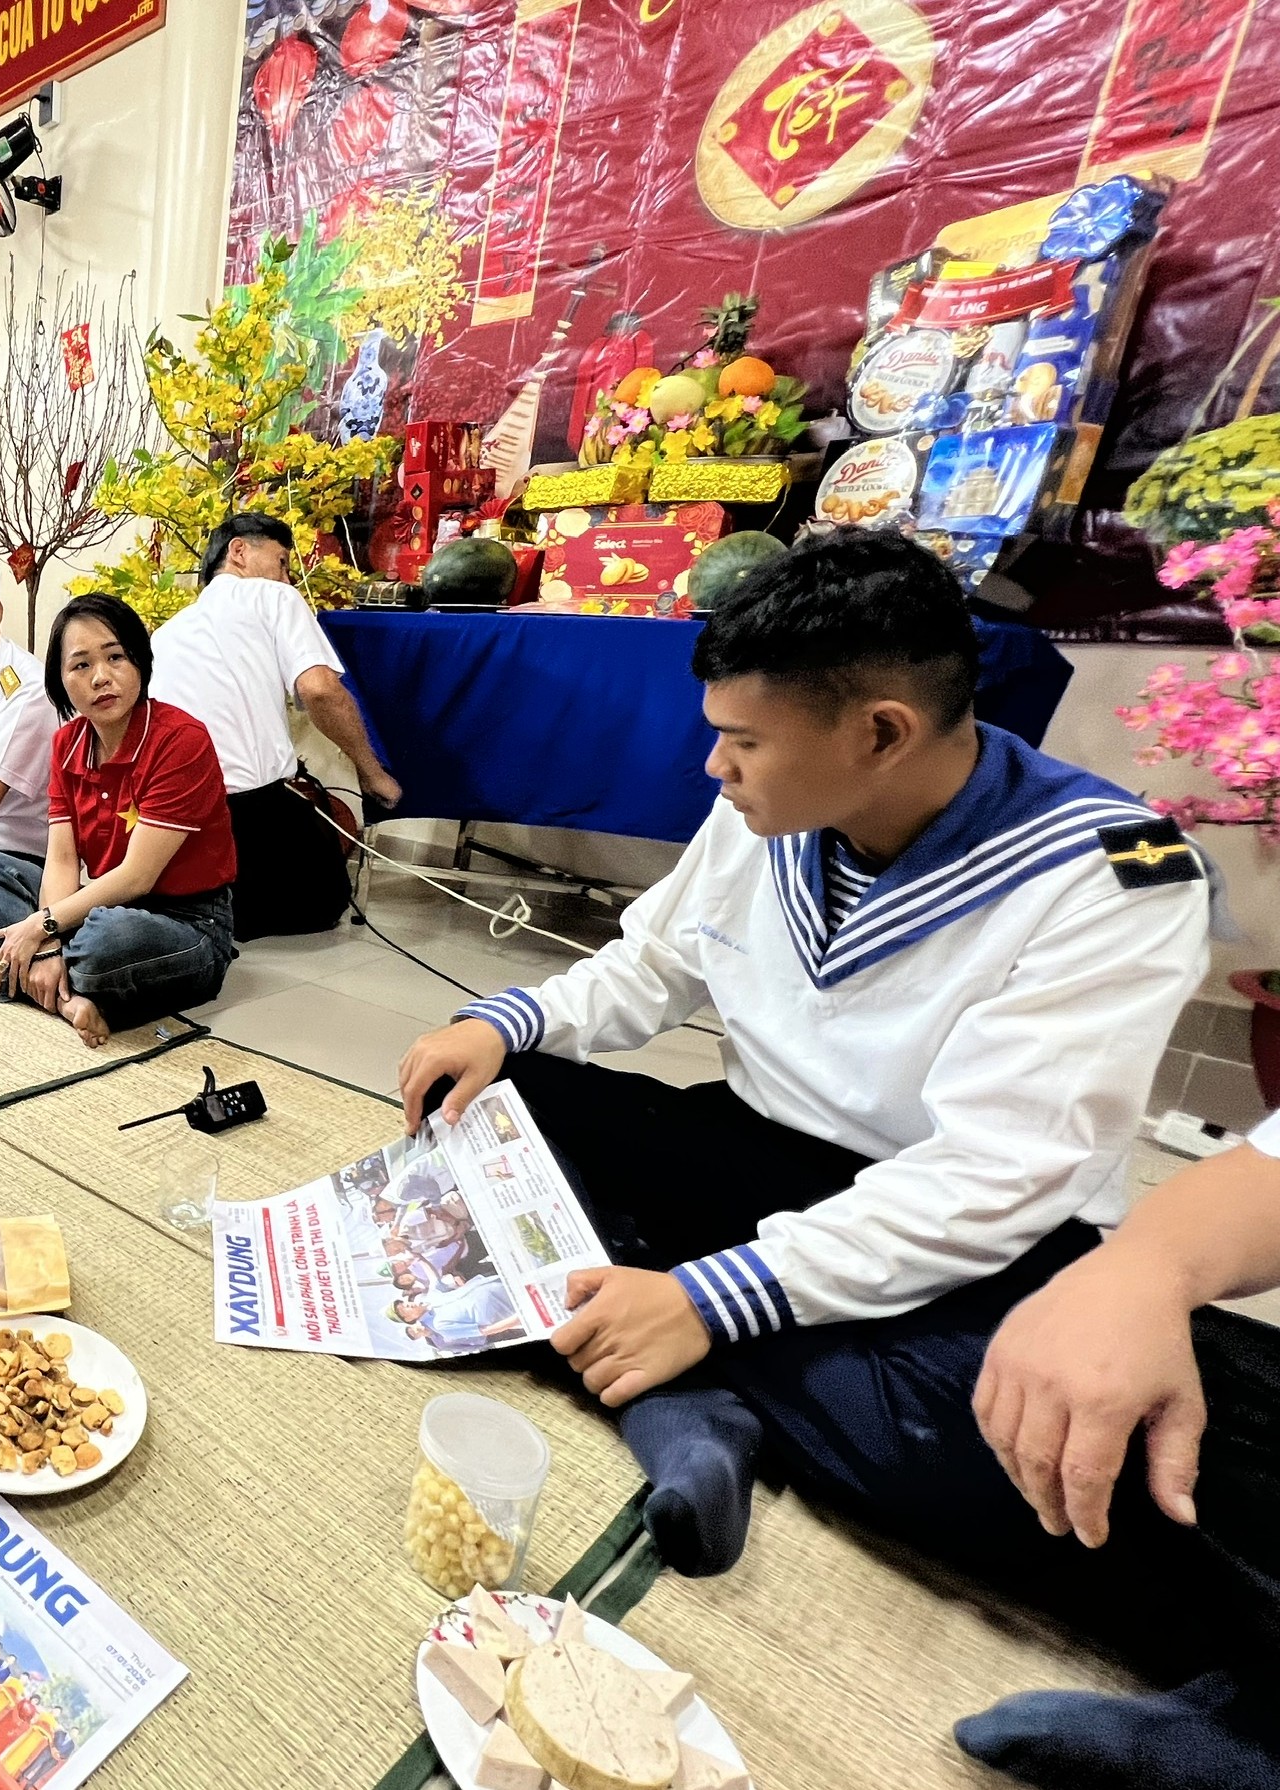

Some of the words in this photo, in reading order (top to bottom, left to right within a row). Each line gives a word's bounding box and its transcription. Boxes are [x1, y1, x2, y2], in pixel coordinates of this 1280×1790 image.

[593, 539, 627, 549] Select
[288, 1214, 303, 1243] TRÌNH
[311, 1227, 323, 1245] THI
[295, 1246, 307, 1270] CÔNG
[313, 1268, 331, 1287] KẾT
[105, 1644, 148, 1686] 07/01/2026
[129, 1652, 146, 1669] Thứ
